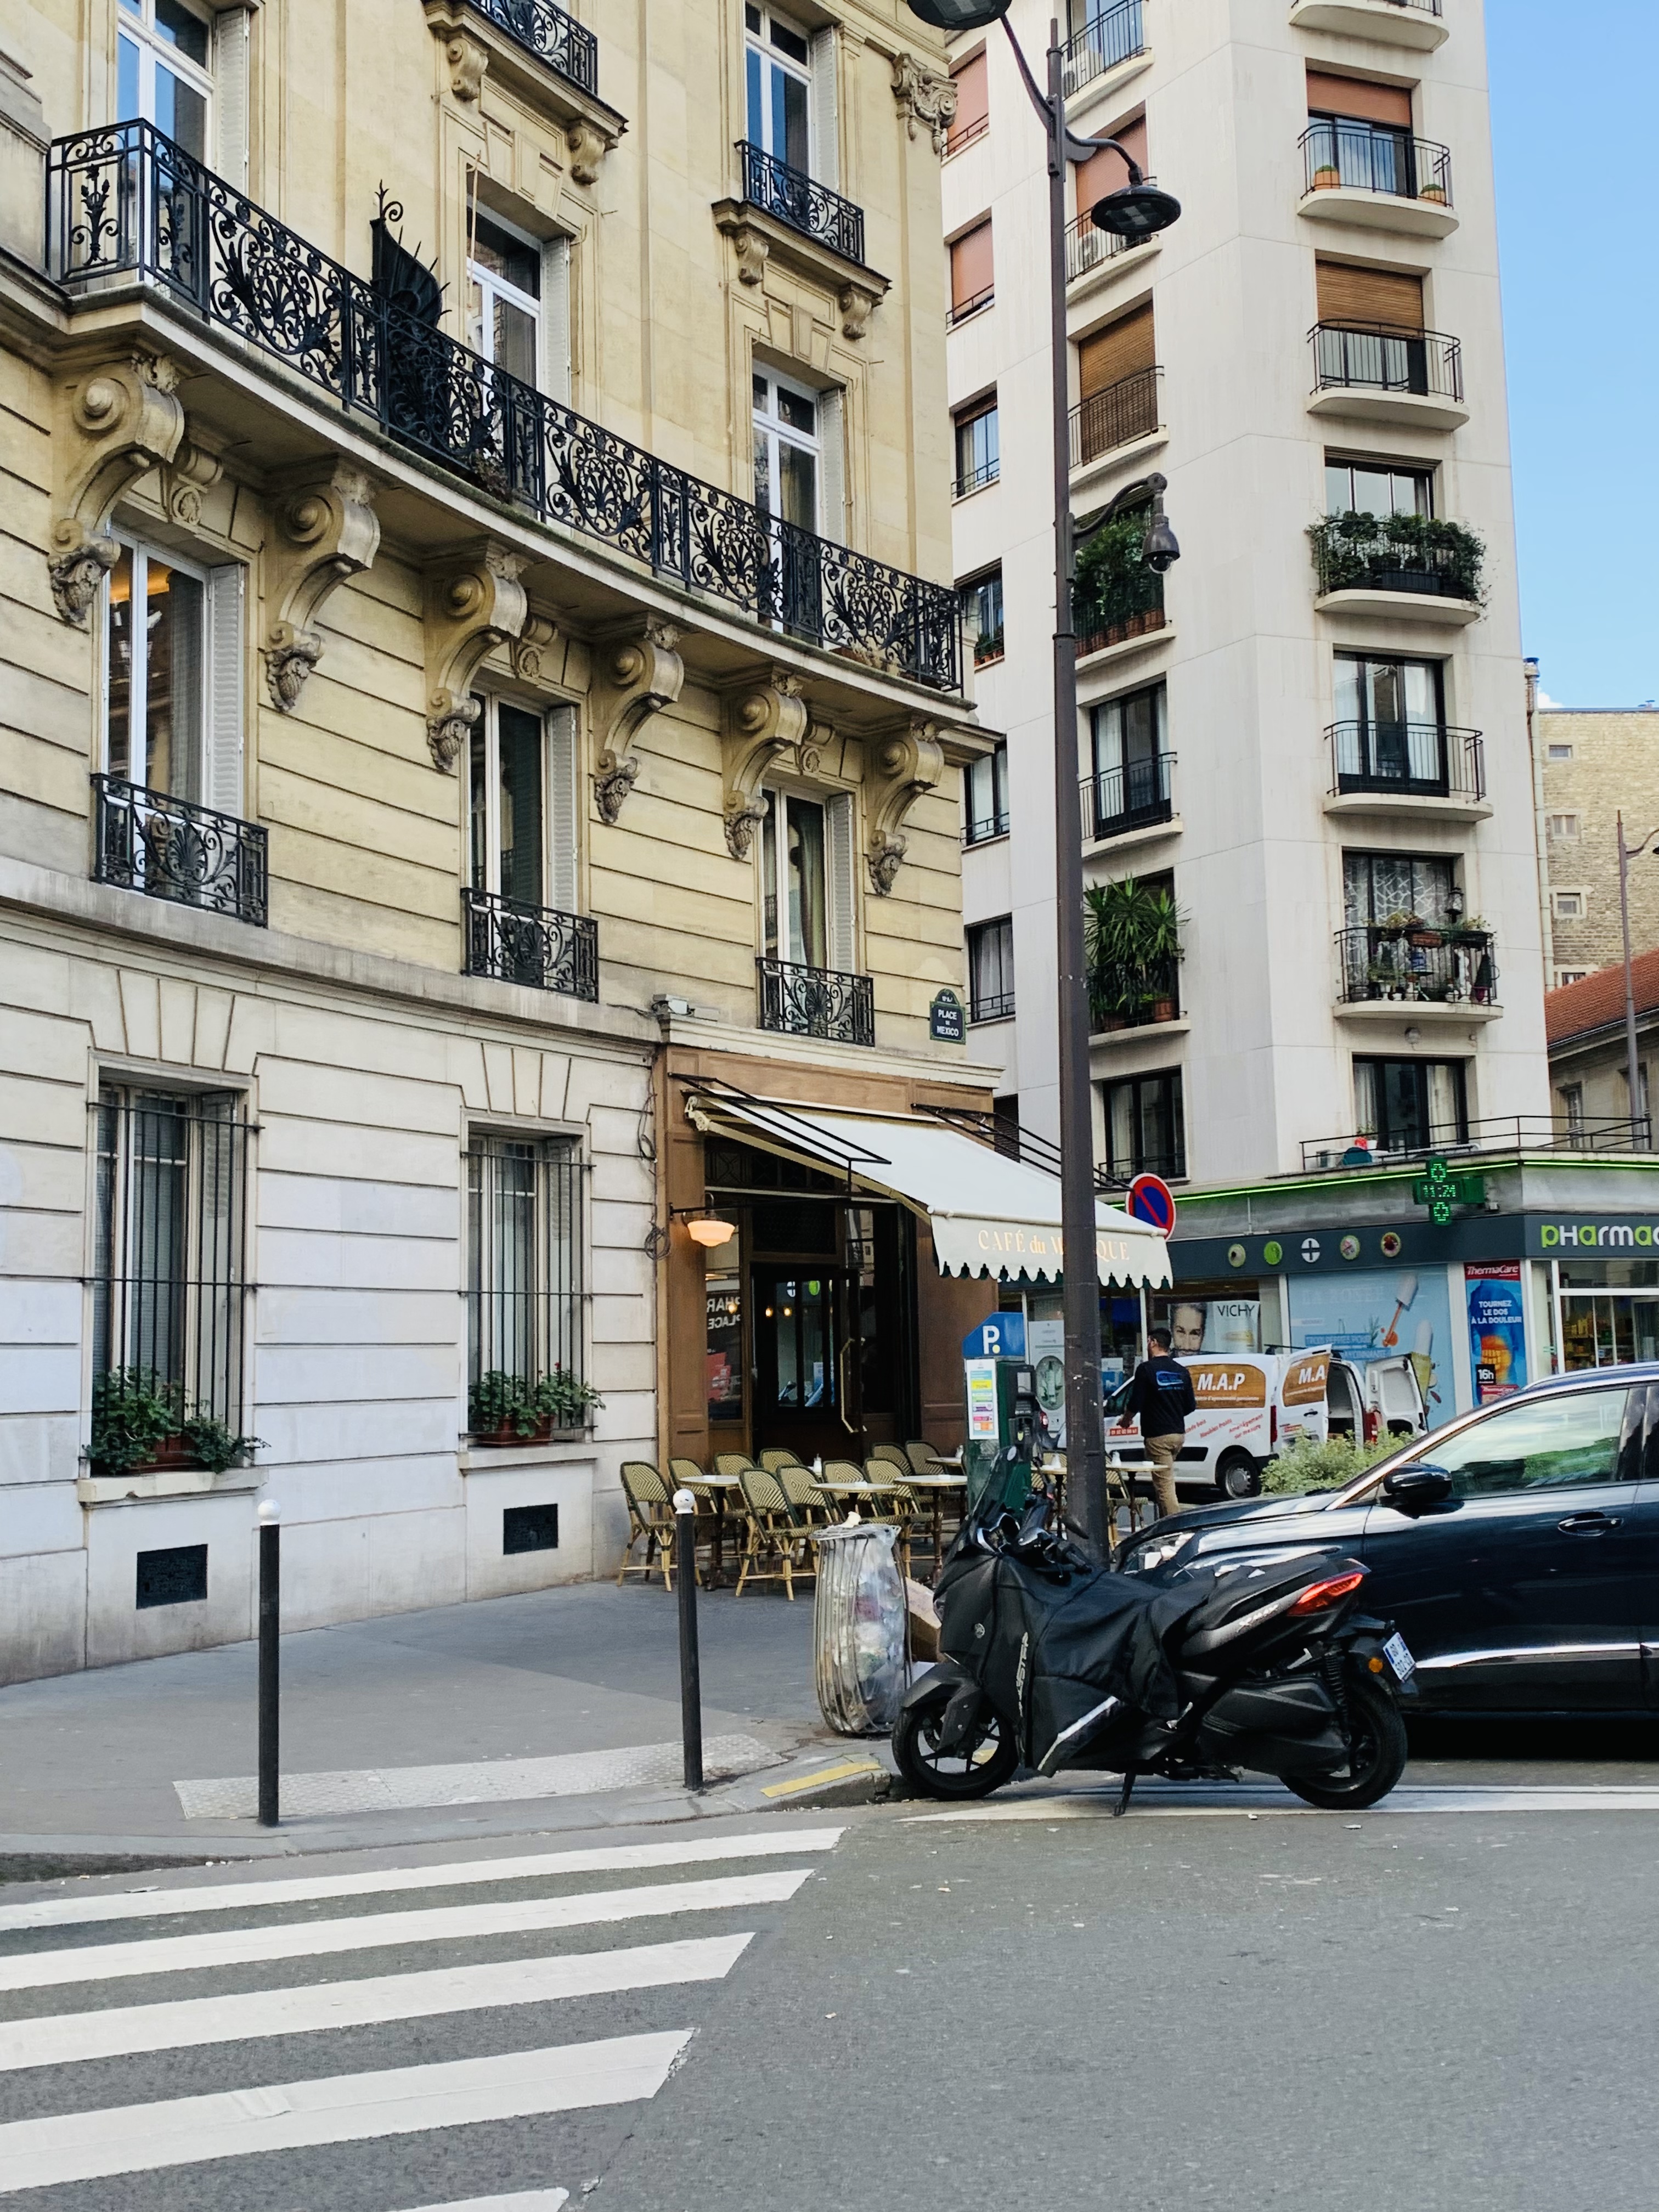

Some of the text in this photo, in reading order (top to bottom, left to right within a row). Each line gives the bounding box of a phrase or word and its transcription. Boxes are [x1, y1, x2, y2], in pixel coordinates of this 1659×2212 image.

[938, 1009, 957, 1020] PLACE
[936, 1025, 959, 1036] MEXICO
[978, 1229, 1130, 1262] CAFÉ du MQUE
[1467, 1265, 1519, 1275] ThermaCare
[1217, 1304, 1255, 1317] VICHY
[1477, 1369, 1494, 1380] 16h
[1197, 1373, 1245, 1390] M.A.P
